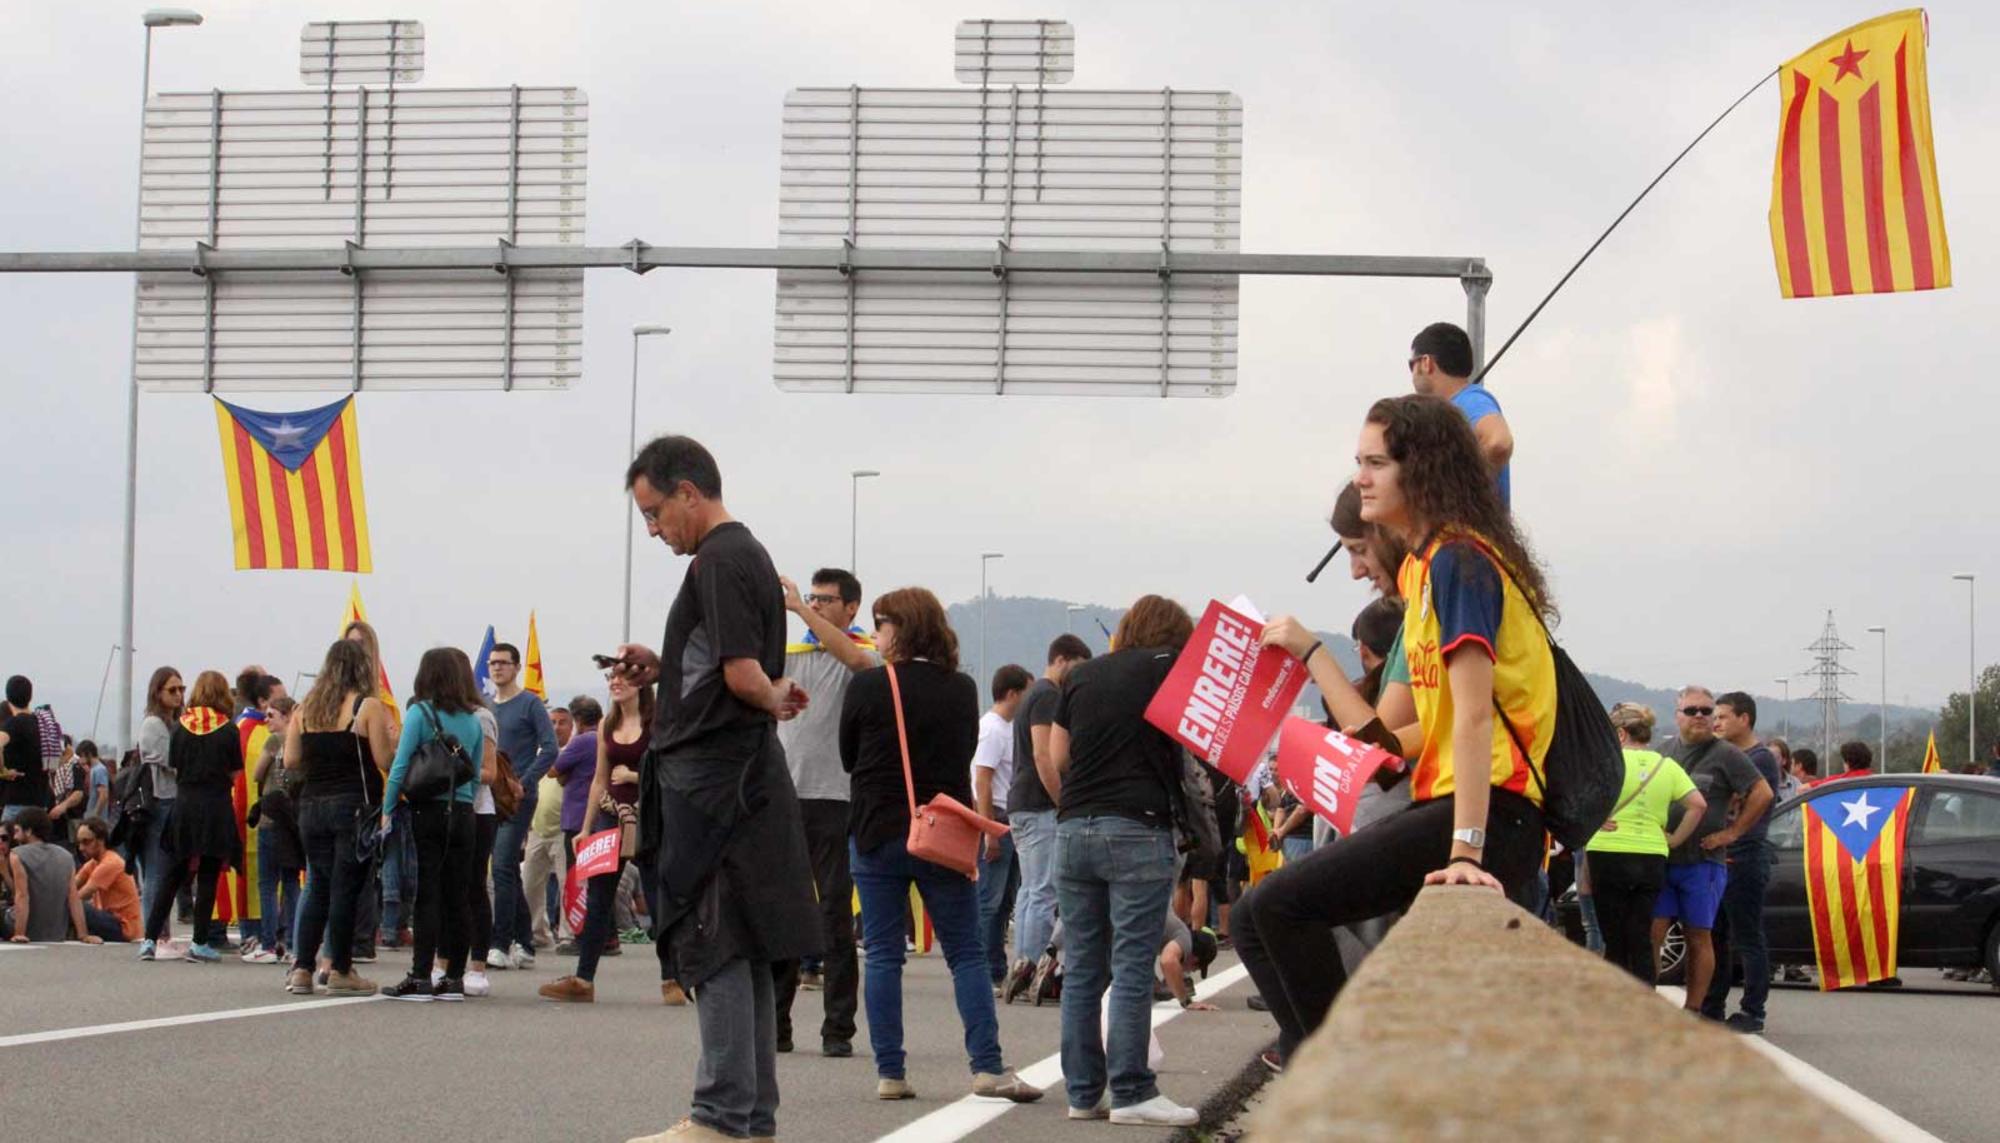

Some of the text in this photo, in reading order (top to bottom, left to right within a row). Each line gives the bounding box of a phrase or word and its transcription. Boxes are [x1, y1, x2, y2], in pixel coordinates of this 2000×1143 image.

[1177, 611, 1252, 752] ENRERE!
[1216, 715, 1234, 744] DELS
[1225, 682, 1247, 721] PAÏSOS
[1239, 638, 1261, 686] CATALANS
[1262, 667, 1288, 709] endavant
[1312, 754, 1342, 814] UN
